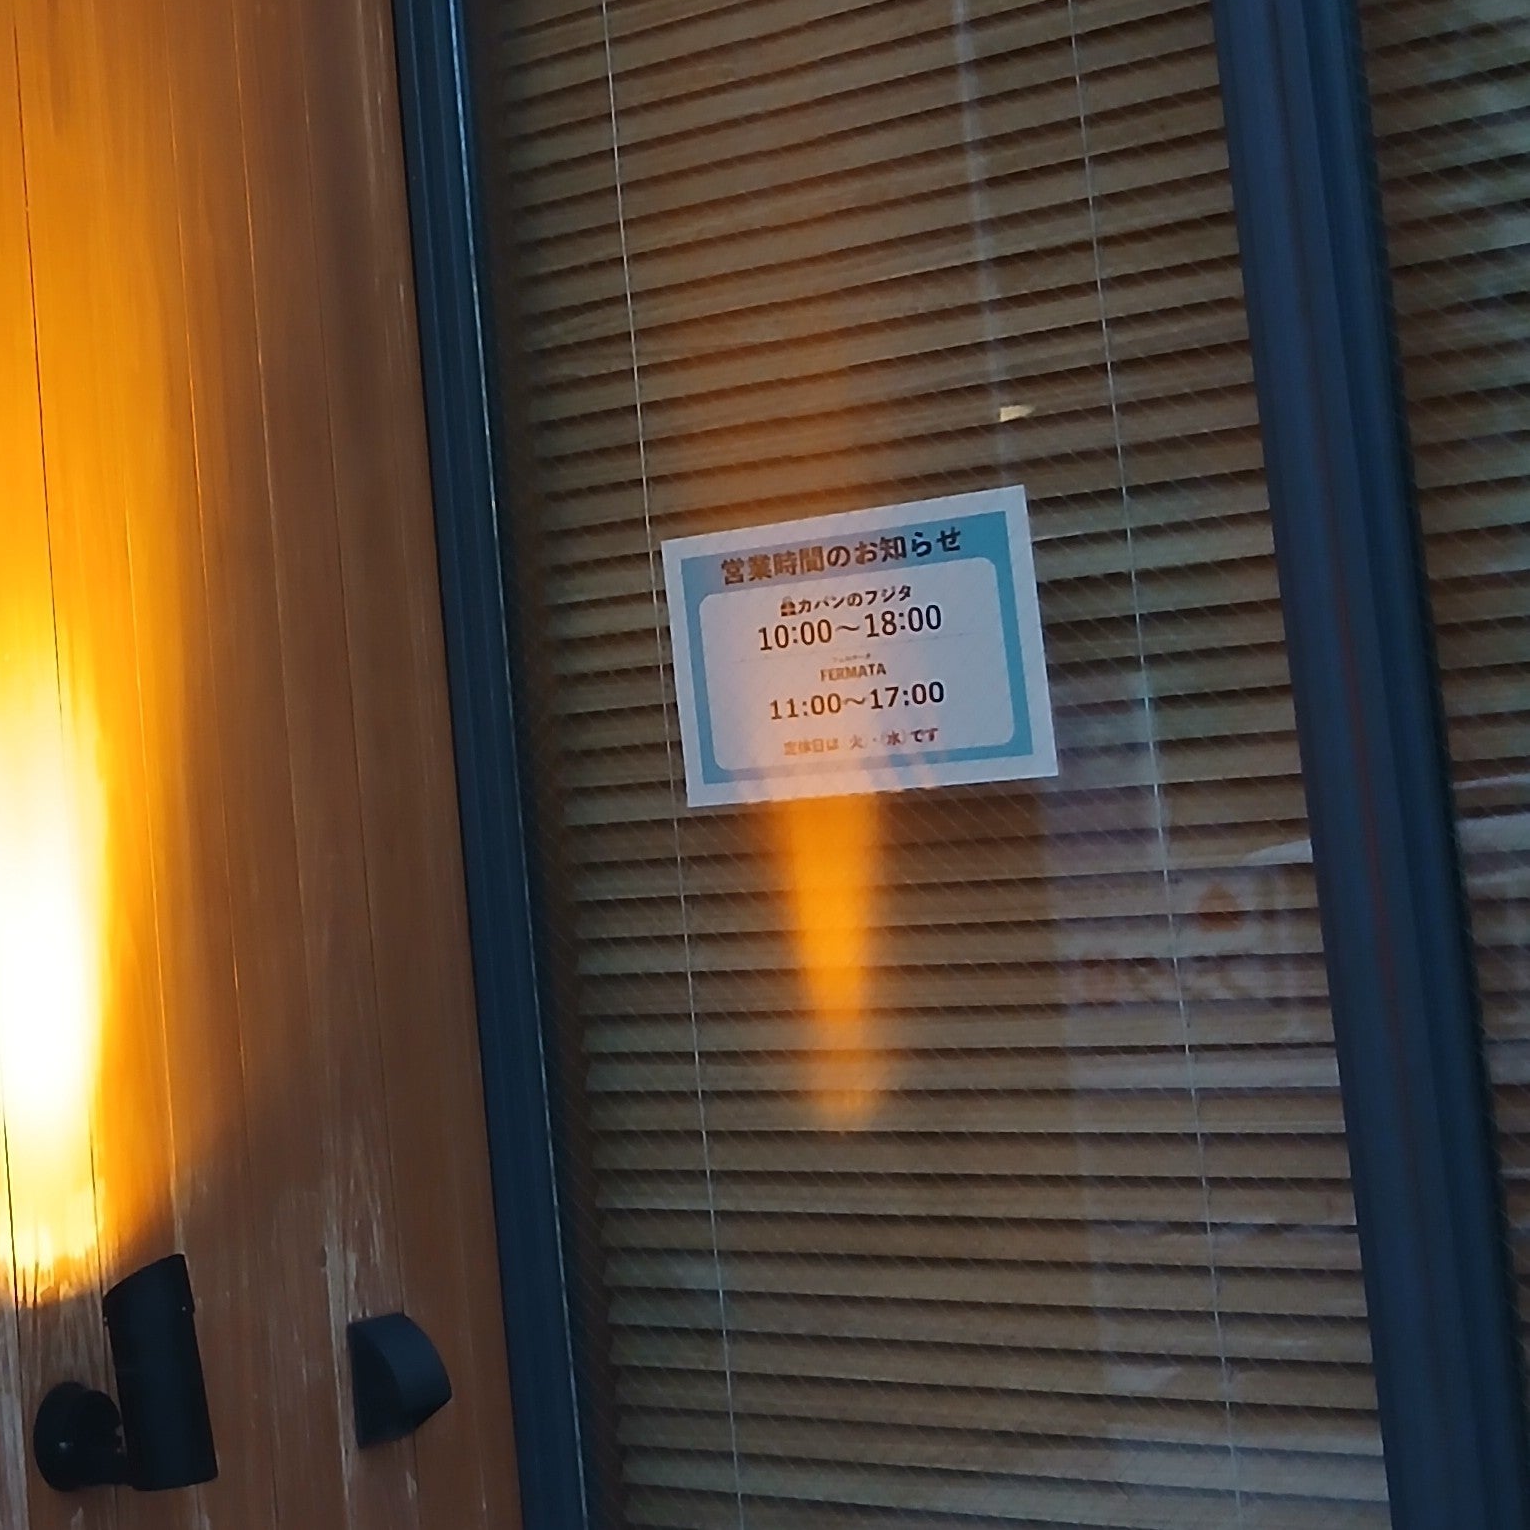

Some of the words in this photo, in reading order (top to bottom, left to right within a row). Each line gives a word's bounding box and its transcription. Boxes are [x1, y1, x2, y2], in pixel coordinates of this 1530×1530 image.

[721, 526, 962, 586] 営業時間のお知らせ
[798, 584, 913, 614] カバンのフジタ
[819, 662, 888, 682] FERMATA
